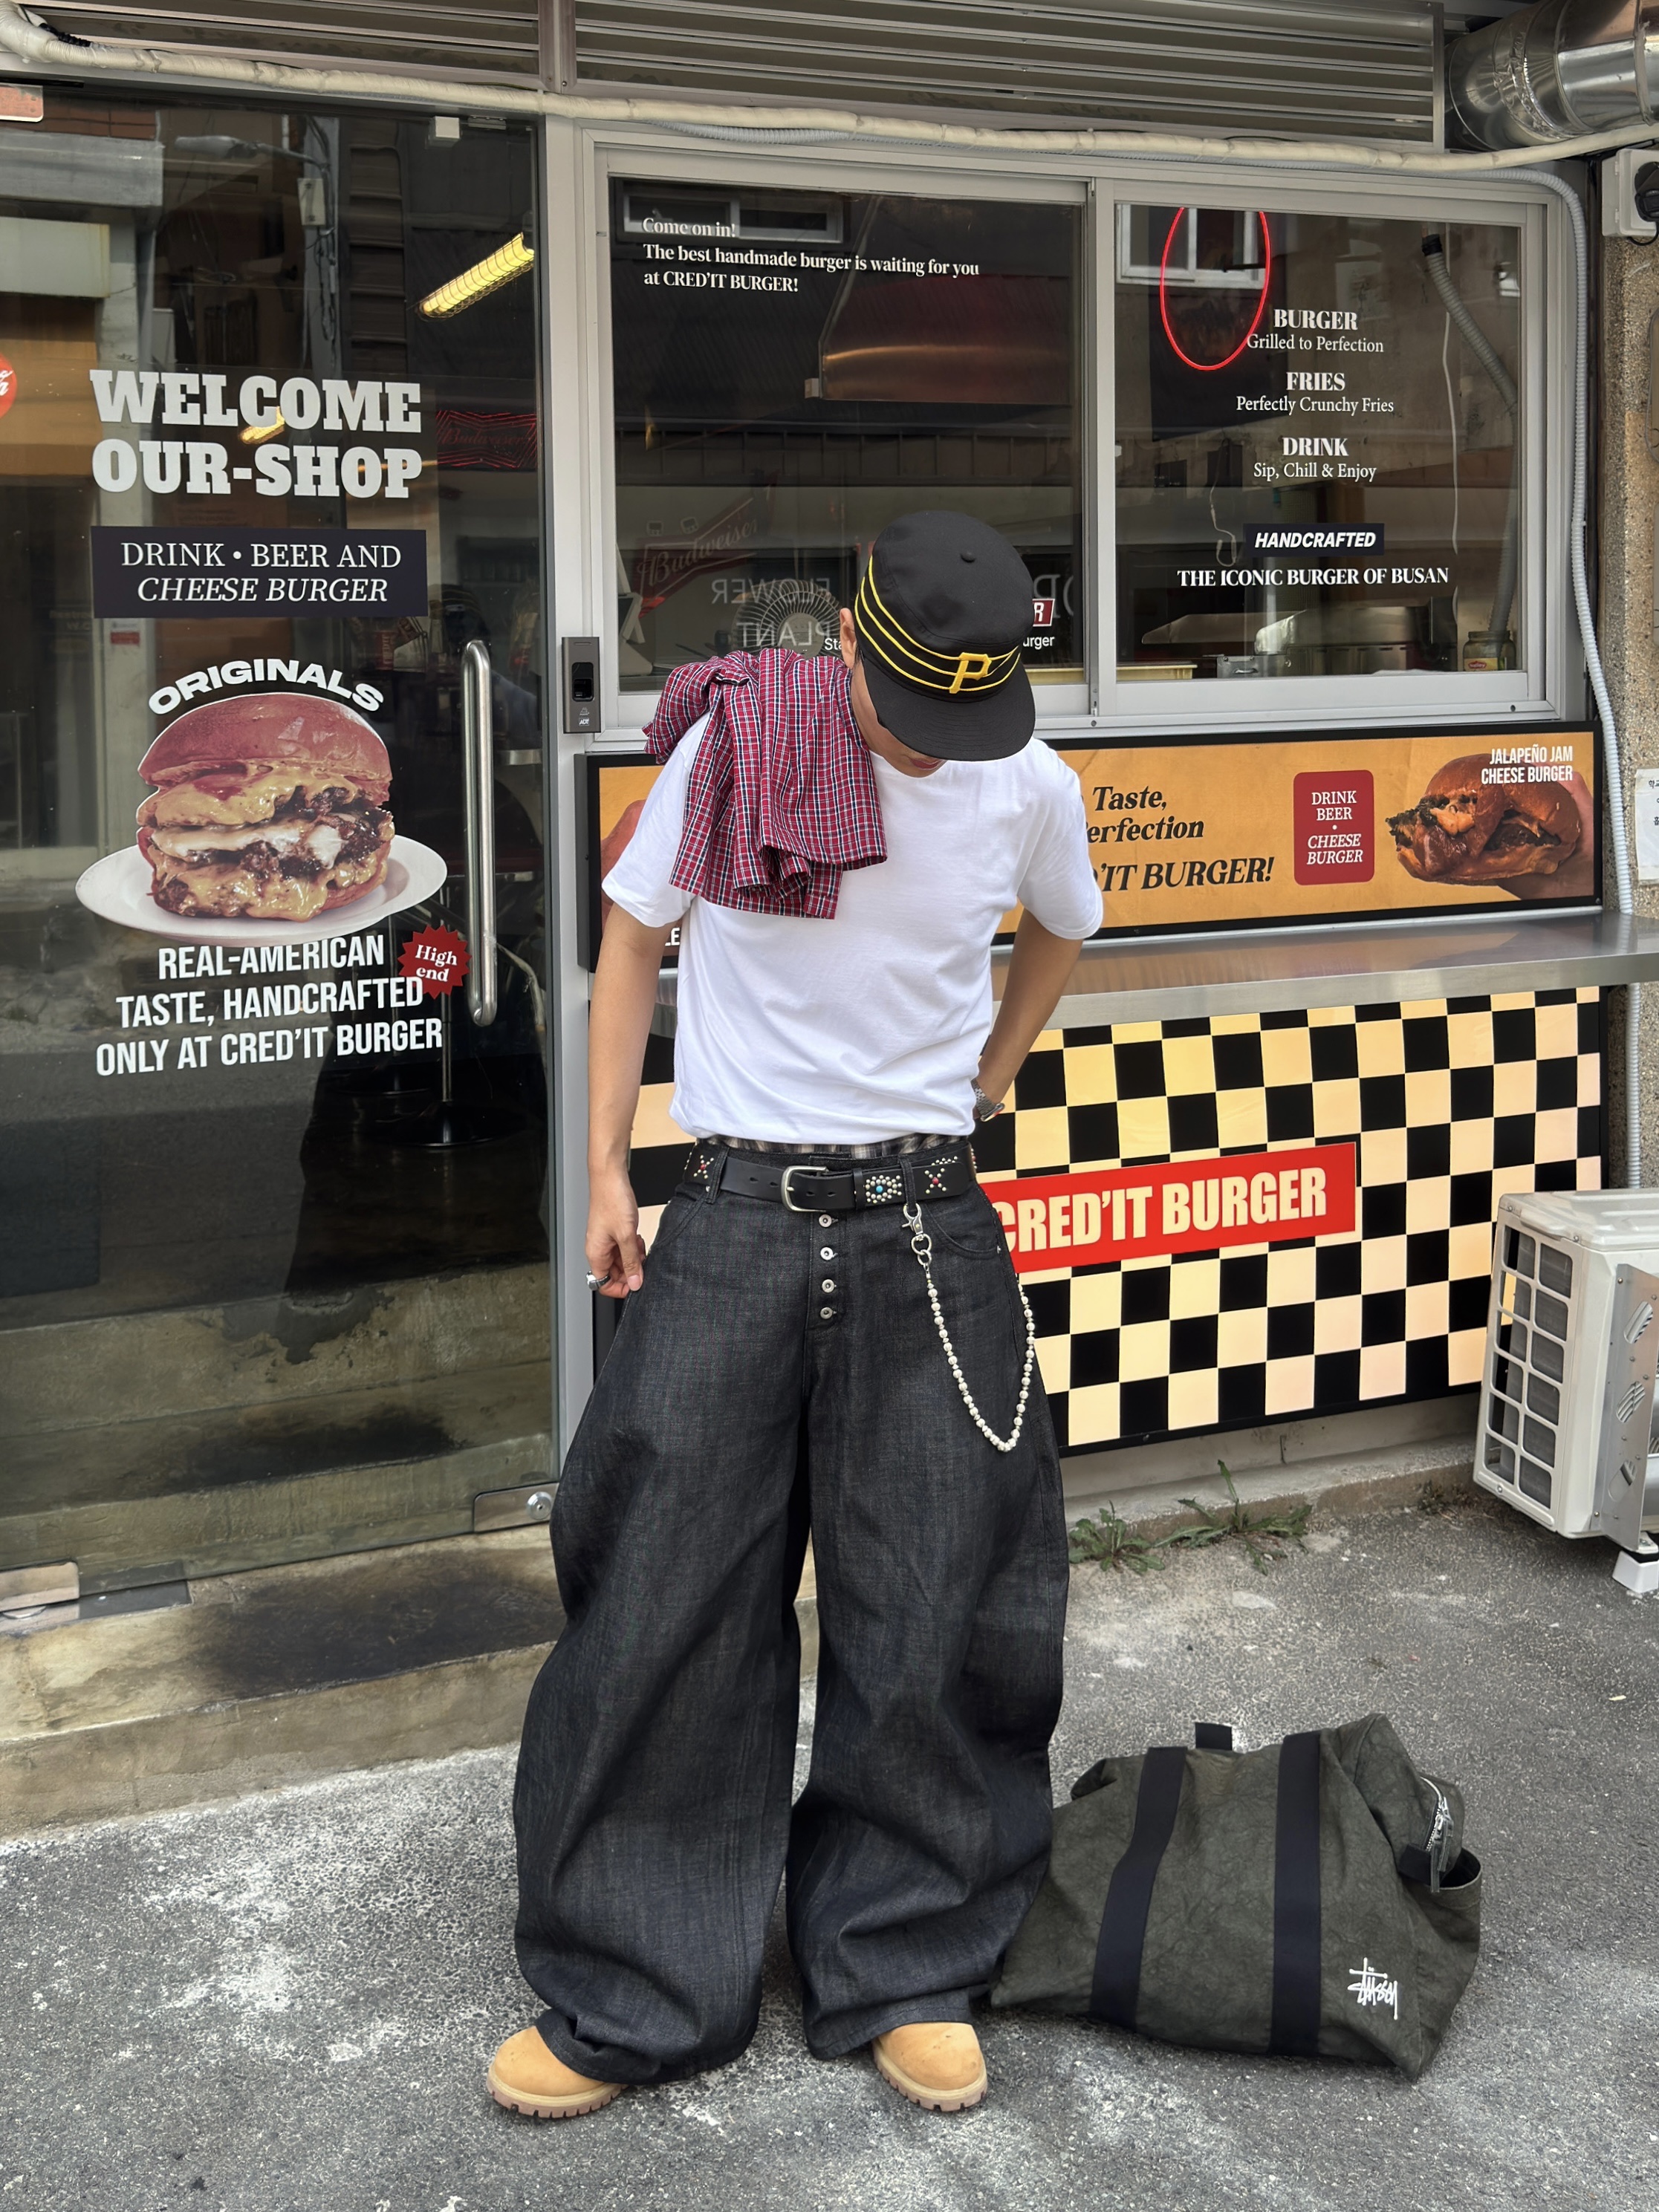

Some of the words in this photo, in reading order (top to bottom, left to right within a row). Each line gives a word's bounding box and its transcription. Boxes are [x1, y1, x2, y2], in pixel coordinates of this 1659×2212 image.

[642, 218, 688, 235] Come
[692, 224, 712, 236] on
[715, 221, 736, 238] in!
[643, 243, 675, 261] The
[678, 245, 712, 263] best
[715, 247, 797, 267] handmade
[800, 252, 851, 273] burger
[854, 255, 867, 271] is
[870, 257, 925, 277] waiting
[928, 258, 951, 274] for
[952, 261, 980, 279] you
[643, 270, 660, 286] at
[663, 270, 727, 289] CRED'IT
[730, 274, 799, 293] BURGER!
[1273, 309, 1358, 331] BURGER
[1247, 334, 1295, 350] Grilled
[1299, 338, 1312, 351] to
[1316, 336, 1384, 353] Perfection
[1286, 371, 1345, 391] FRIES
[89, 368, 422, 433] WELCOME
[1236, 395, 1296, 416] Perfectly
[1299, 397, 1359, 417] Crunchy
[1362, 397, 1395, 412] Fries
[1282, 437, 1349, 457] DRINK
[91, 438, 422, 499] OUR-SHOP
[1253, 462, 1279, 482] Sip,
[1283, 462, 1318, 478] Chill
[1322, 463, 1334, 478] &
[1337, 463, 1377, 483] Enjoy
[1254, 532, 1377, 548] HANDCRAFTED
[120, 542, 225, 567] DRINK
[250, 544, 330, 568] BEER
[337, 544, 402, 568] AND
[637, 517, 758, 588] Budweiser
[1177, 570, 1215, 588] THE
[1220, 568, 1283, 587] ICONIC
[1287, 567, 1360, 586] BURGER
[1363, 567, 1387, 585] OF
[1391, 567, 1449, 585] BUSAN
[137, 577, 259, 602] CHEESE
[265, 578, 389, 602] BURGER
[1022, 636, 1055, 650] urger
[949, 651, 992, 694] P
[148, 657, 384, 715] ORIGINALS
[1489, 744, 1547, 766] JALAPEÑO
[1550, 746, 1574, 763] JAM
[1481, 767, 1525, 786] CHEESE
[1527, 765, 1574, 784] BURGER
[1092, 786, 1167, 811] Taste,
[1311, 790, 1357, 806] DRINK
[1316, 807, 1352, 822] BEER
[1085, 816, 1204, 844] erfection
[1307, 833, 1361, 849] CHEESE
[1306, 850, 1363, 865] BURGER
[1140, 856, 1275, 890] BURGER!
[158, 934, 384, 980] REAL-AMERICAN
[415, 944, 458, 968] High
[415, 968, 449, 983] end
[115, 992, 215, 1029] TASTE,
[224, 976, 424, 1021] HANDCRAFTED
[96, 1039, 169, 1077] ONLY
[177, 1035, 212, 1070] AT
[221, 1026, 329, 1067] CRED'IT
[337, 1018, 444, 1056] BURGER
[1162, 1166, 1327, 1235] BURGER
